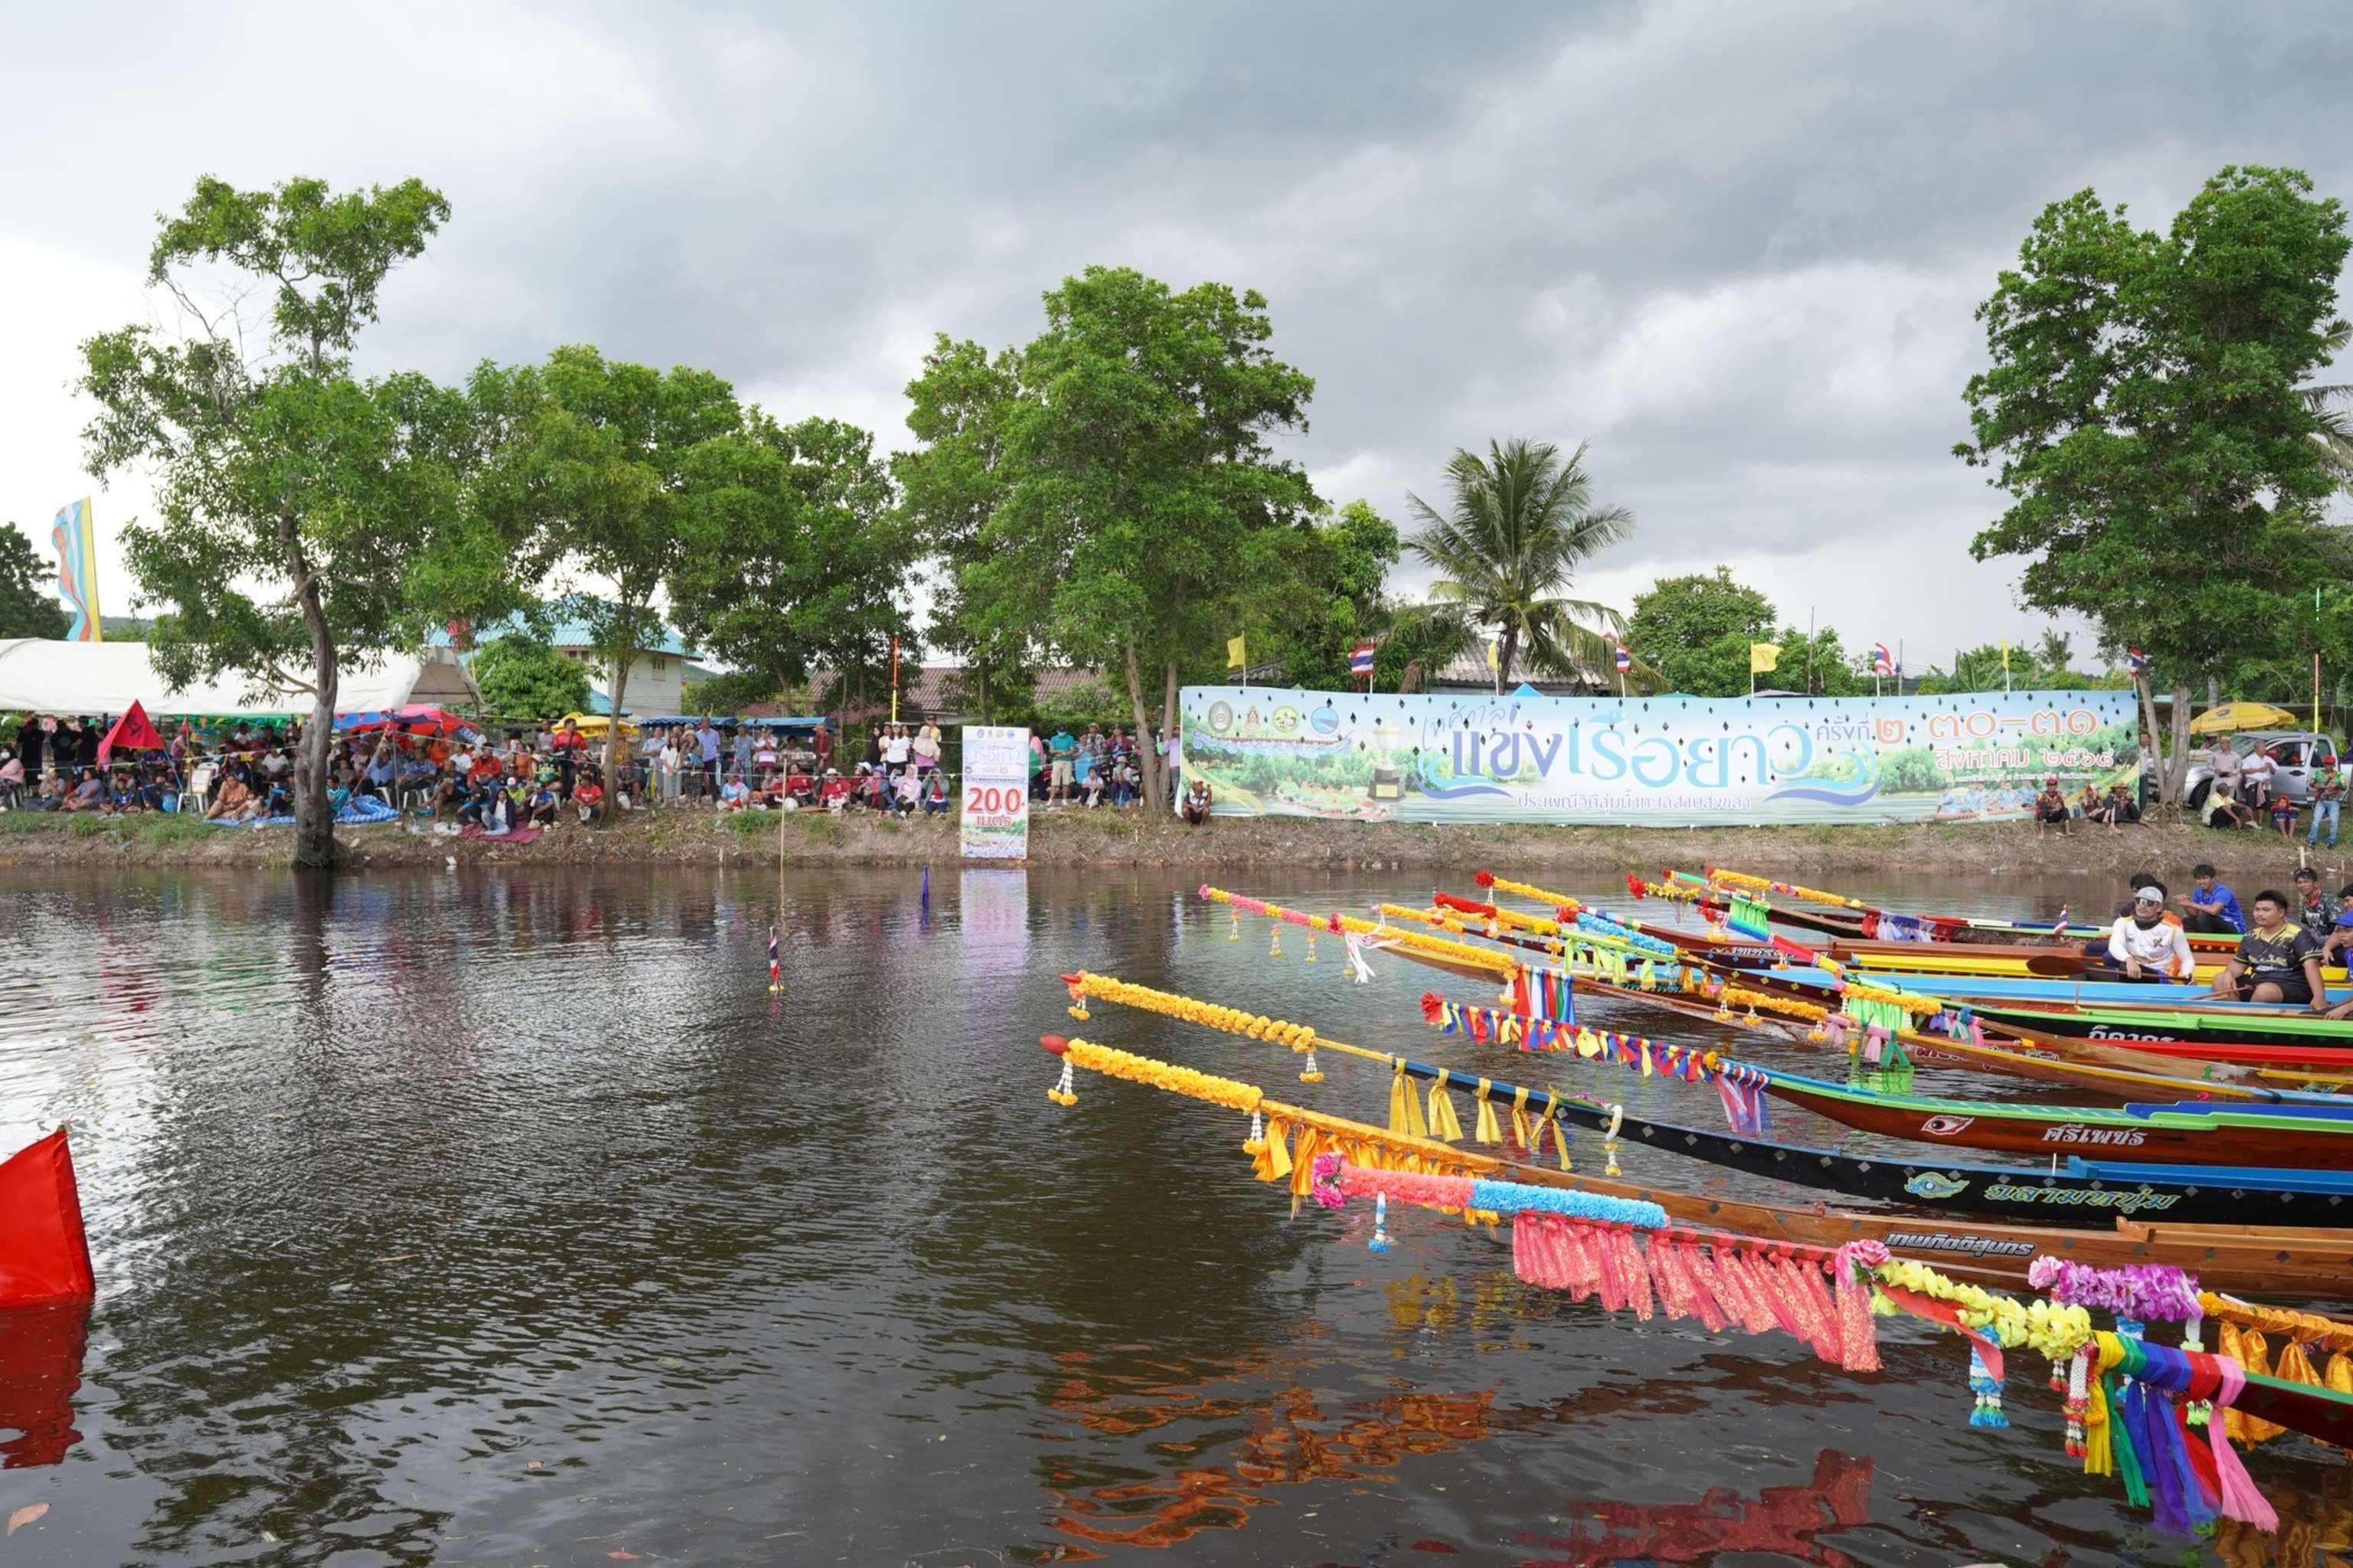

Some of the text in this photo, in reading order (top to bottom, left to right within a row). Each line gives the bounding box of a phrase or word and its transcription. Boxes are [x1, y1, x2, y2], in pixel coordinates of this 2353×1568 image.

[1816, 712, 1905, 745] ครั้งที่ ๒
[1934, 748, 2030, 770] สิงหาคม
[967, 787, 1023, 815] 200
[977, 814, 1012, 827] เมตร
[2042, 1123, 2148, 1146] ศรีเพชร
